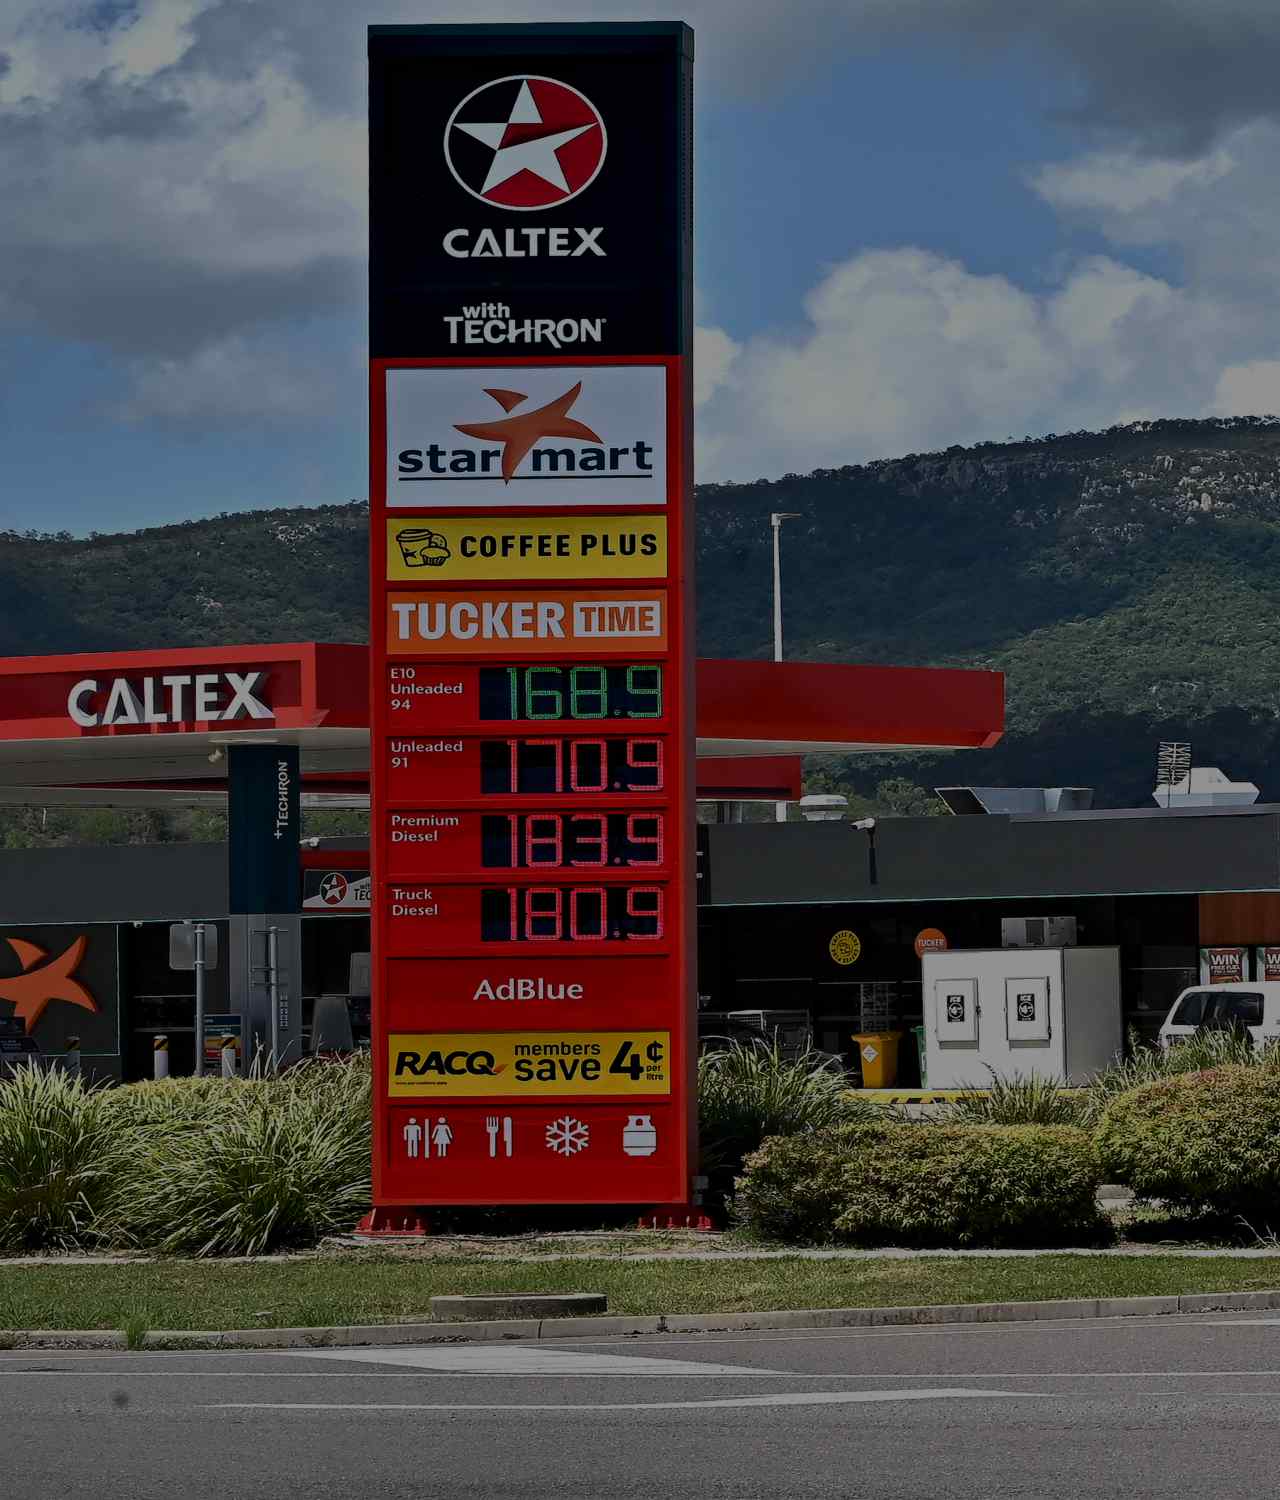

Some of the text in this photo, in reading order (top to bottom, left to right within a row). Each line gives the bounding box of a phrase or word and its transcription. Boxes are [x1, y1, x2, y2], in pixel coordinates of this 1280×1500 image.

[442, 227, 607, 259] CALTEX
[462, 302, 511, 319] with
[398, 441, 653, 473] star mart
[460, 533, 657, 558] COFFEE PLUS
[392, 601, 655, 640] TUCKER TIME
[67, 671, 276, 728] CALTEX
[391, 682, 464, 695] Unleaded
[391, 665, 663, 720] E10 168.9
[391, 699, 411, 711] 94
[391, 757, 409, 769] 91
[391, 737, 664, 793] Unleaded 170.9
[391, 830, 439, 842] Diesel
[391, 813, 664, 868] Premium 183.9
[391, 904, 438, 916] Diesel
[392, 886, 664, 941] Truck 180.9
[1210, 954, 1240, 965] WIN
[473, 977, 584, 1001] AdBlue
[514, 1041, 601, 1056] members
[395, 1050, 498, 1075] RACQ
[514, 1057, 601, 1082] save
